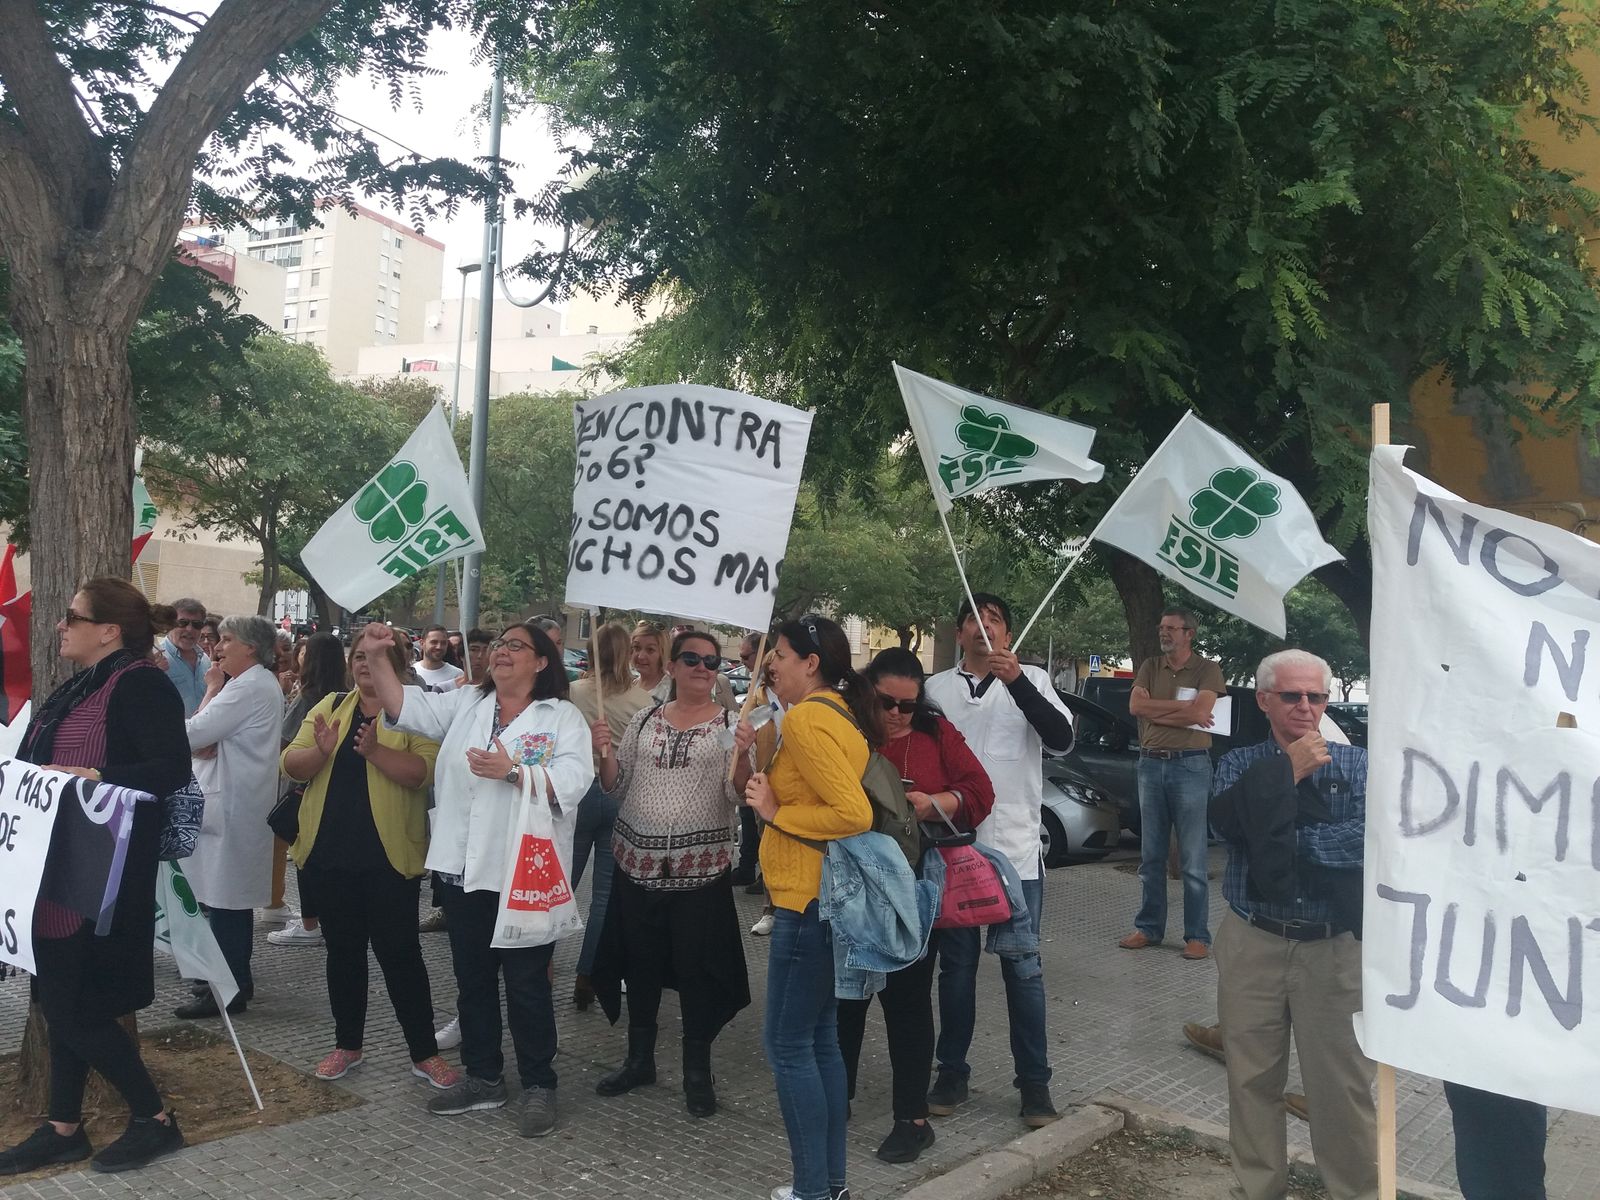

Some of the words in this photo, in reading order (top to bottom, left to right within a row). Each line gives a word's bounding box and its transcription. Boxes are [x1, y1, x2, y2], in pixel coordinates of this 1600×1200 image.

[588, 498, 720, 548] SOMOS
[1159, 520, 1240, 593] FSIE
[1406, 491, 1564, 598] NO
[15, 769, 59, 813] MAS
[1376, 882, 1600, 1031] JUN
